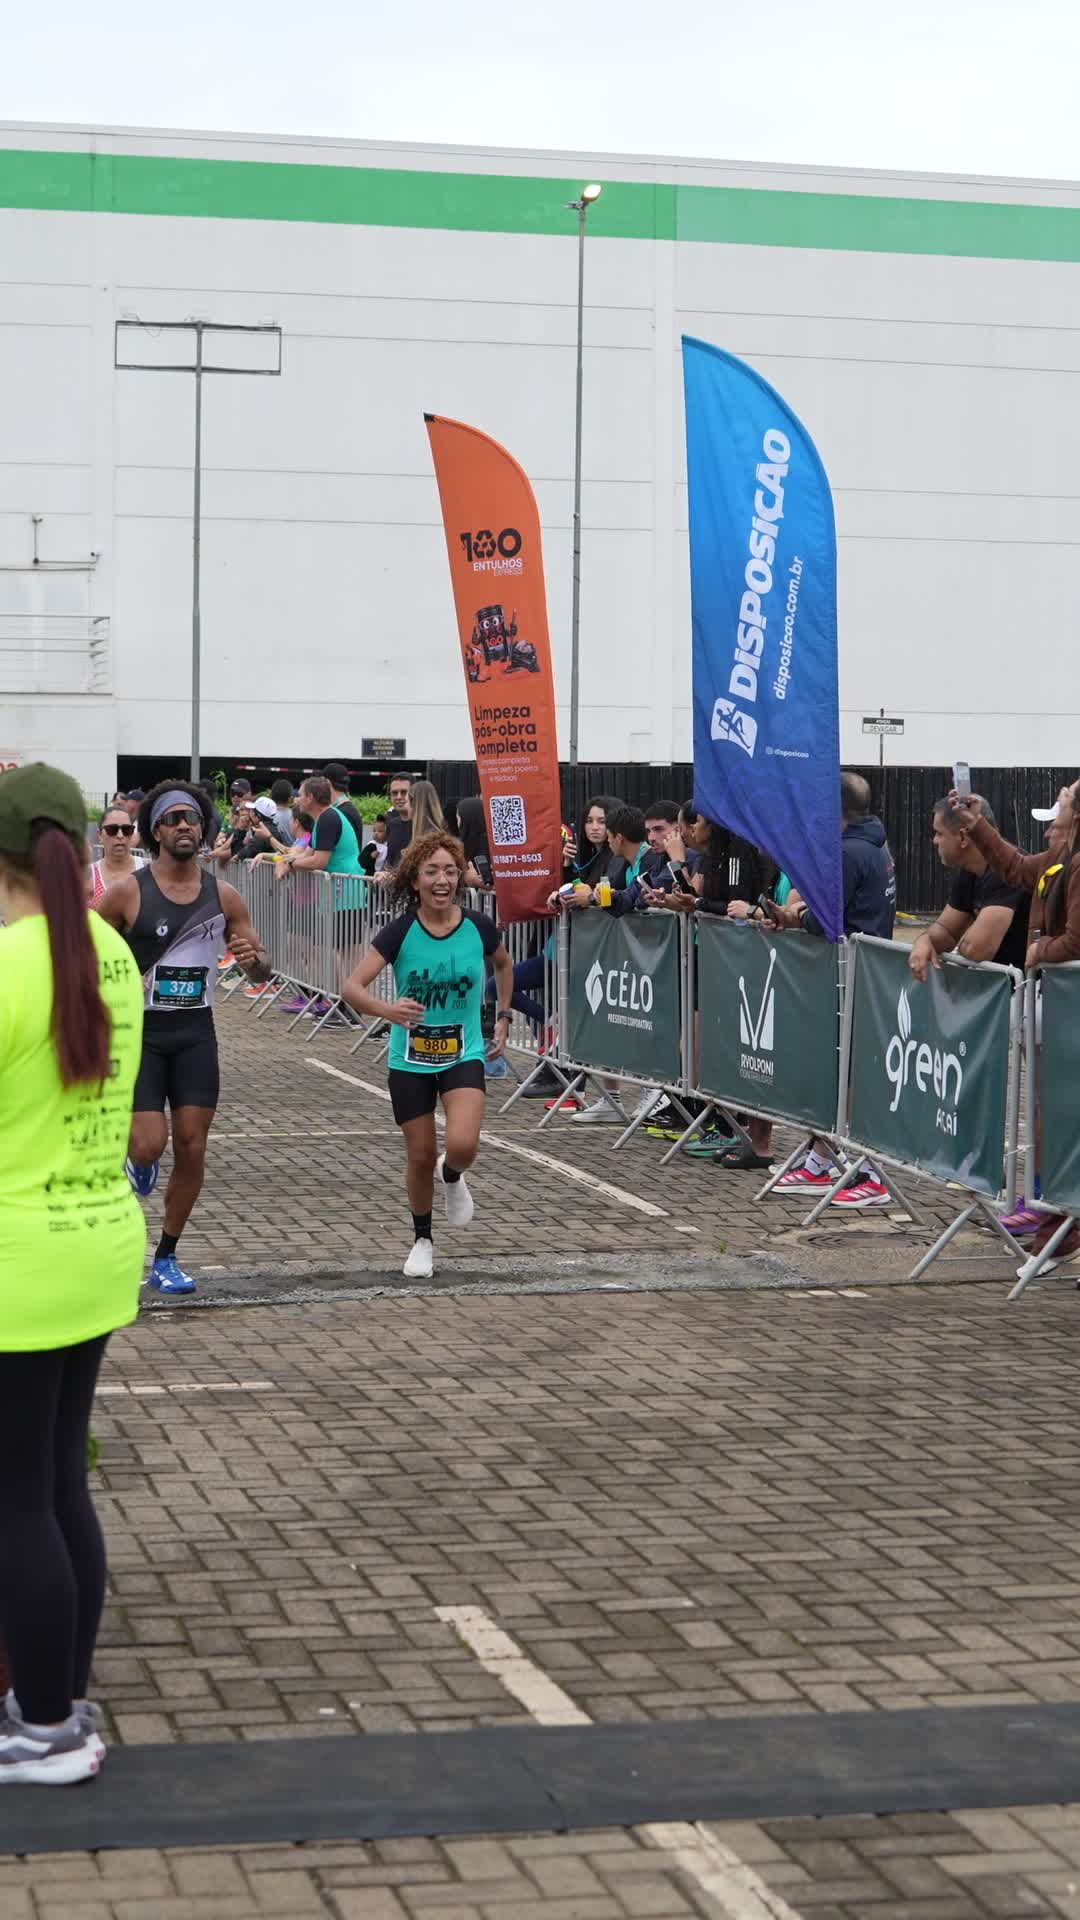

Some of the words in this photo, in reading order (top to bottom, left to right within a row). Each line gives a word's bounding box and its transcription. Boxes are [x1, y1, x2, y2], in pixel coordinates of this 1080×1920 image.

[473, 558, 523, 573] ENTULHOS
[773, 556, 803, 700] disposicao.com.br
[474, 705, 531, 723] Limpeza
[475, 721, 537, 739] pós-obra
[102, 958, 132, 985] AFF
[169, 980, 194, 994] 378
[606, 961, 653, 1013] CÉLO
[423, 1038, 448, 1051] 980
[740, 1053, 774, 1077] RVOLPONI
[885, 1035, 963, 1112] green
